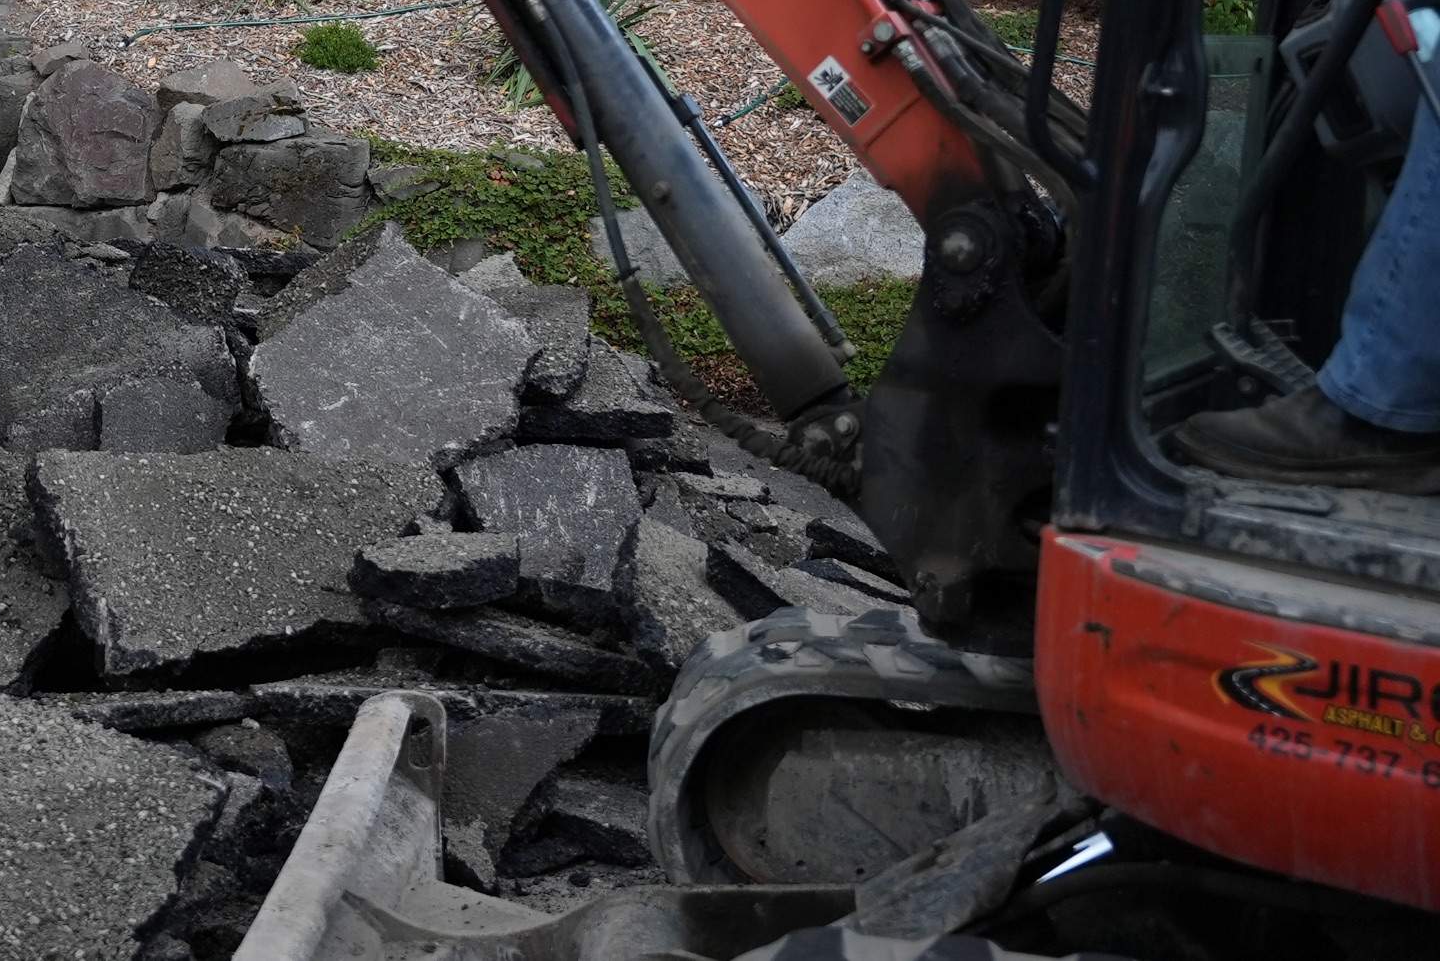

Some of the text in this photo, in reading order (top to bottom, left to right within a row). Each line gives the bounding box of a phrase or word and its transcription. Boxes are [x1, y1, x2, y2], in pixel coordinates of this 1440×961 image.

[1295, 660, 1440, 723] JIR
[1324, 704, 1405, 737] ASPHALT
[1409, 722, 1430, 743] &
